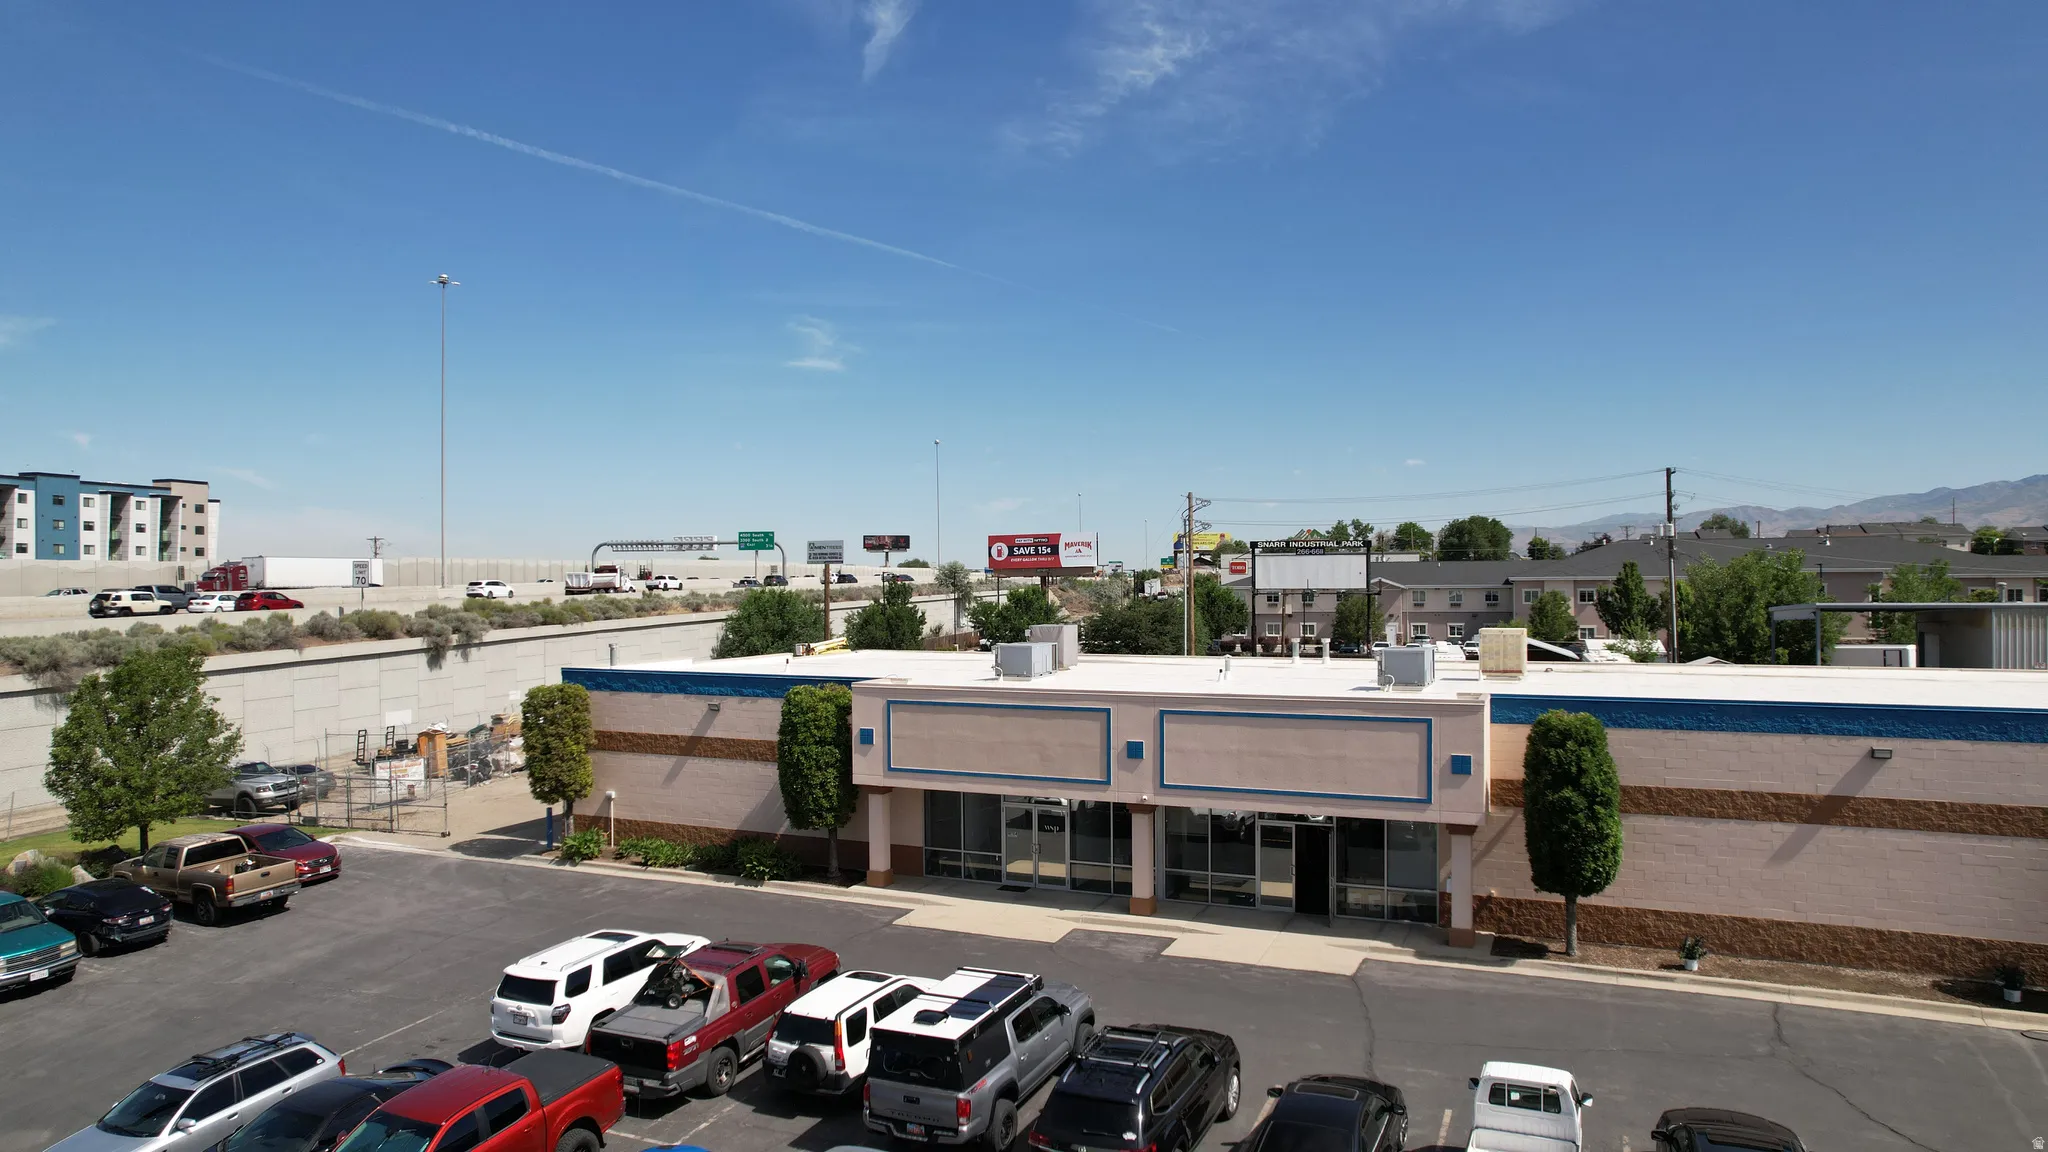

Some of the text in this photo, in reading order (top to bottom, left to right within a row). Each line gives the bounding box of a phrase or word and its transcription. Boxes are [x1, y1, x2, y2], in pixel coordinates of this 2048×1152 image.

[1013, 546, 1052, 555] SAVE 15¢
[1064, 541, 1092, 551] MAVERIK
[355, 576, 367, 585] 70
